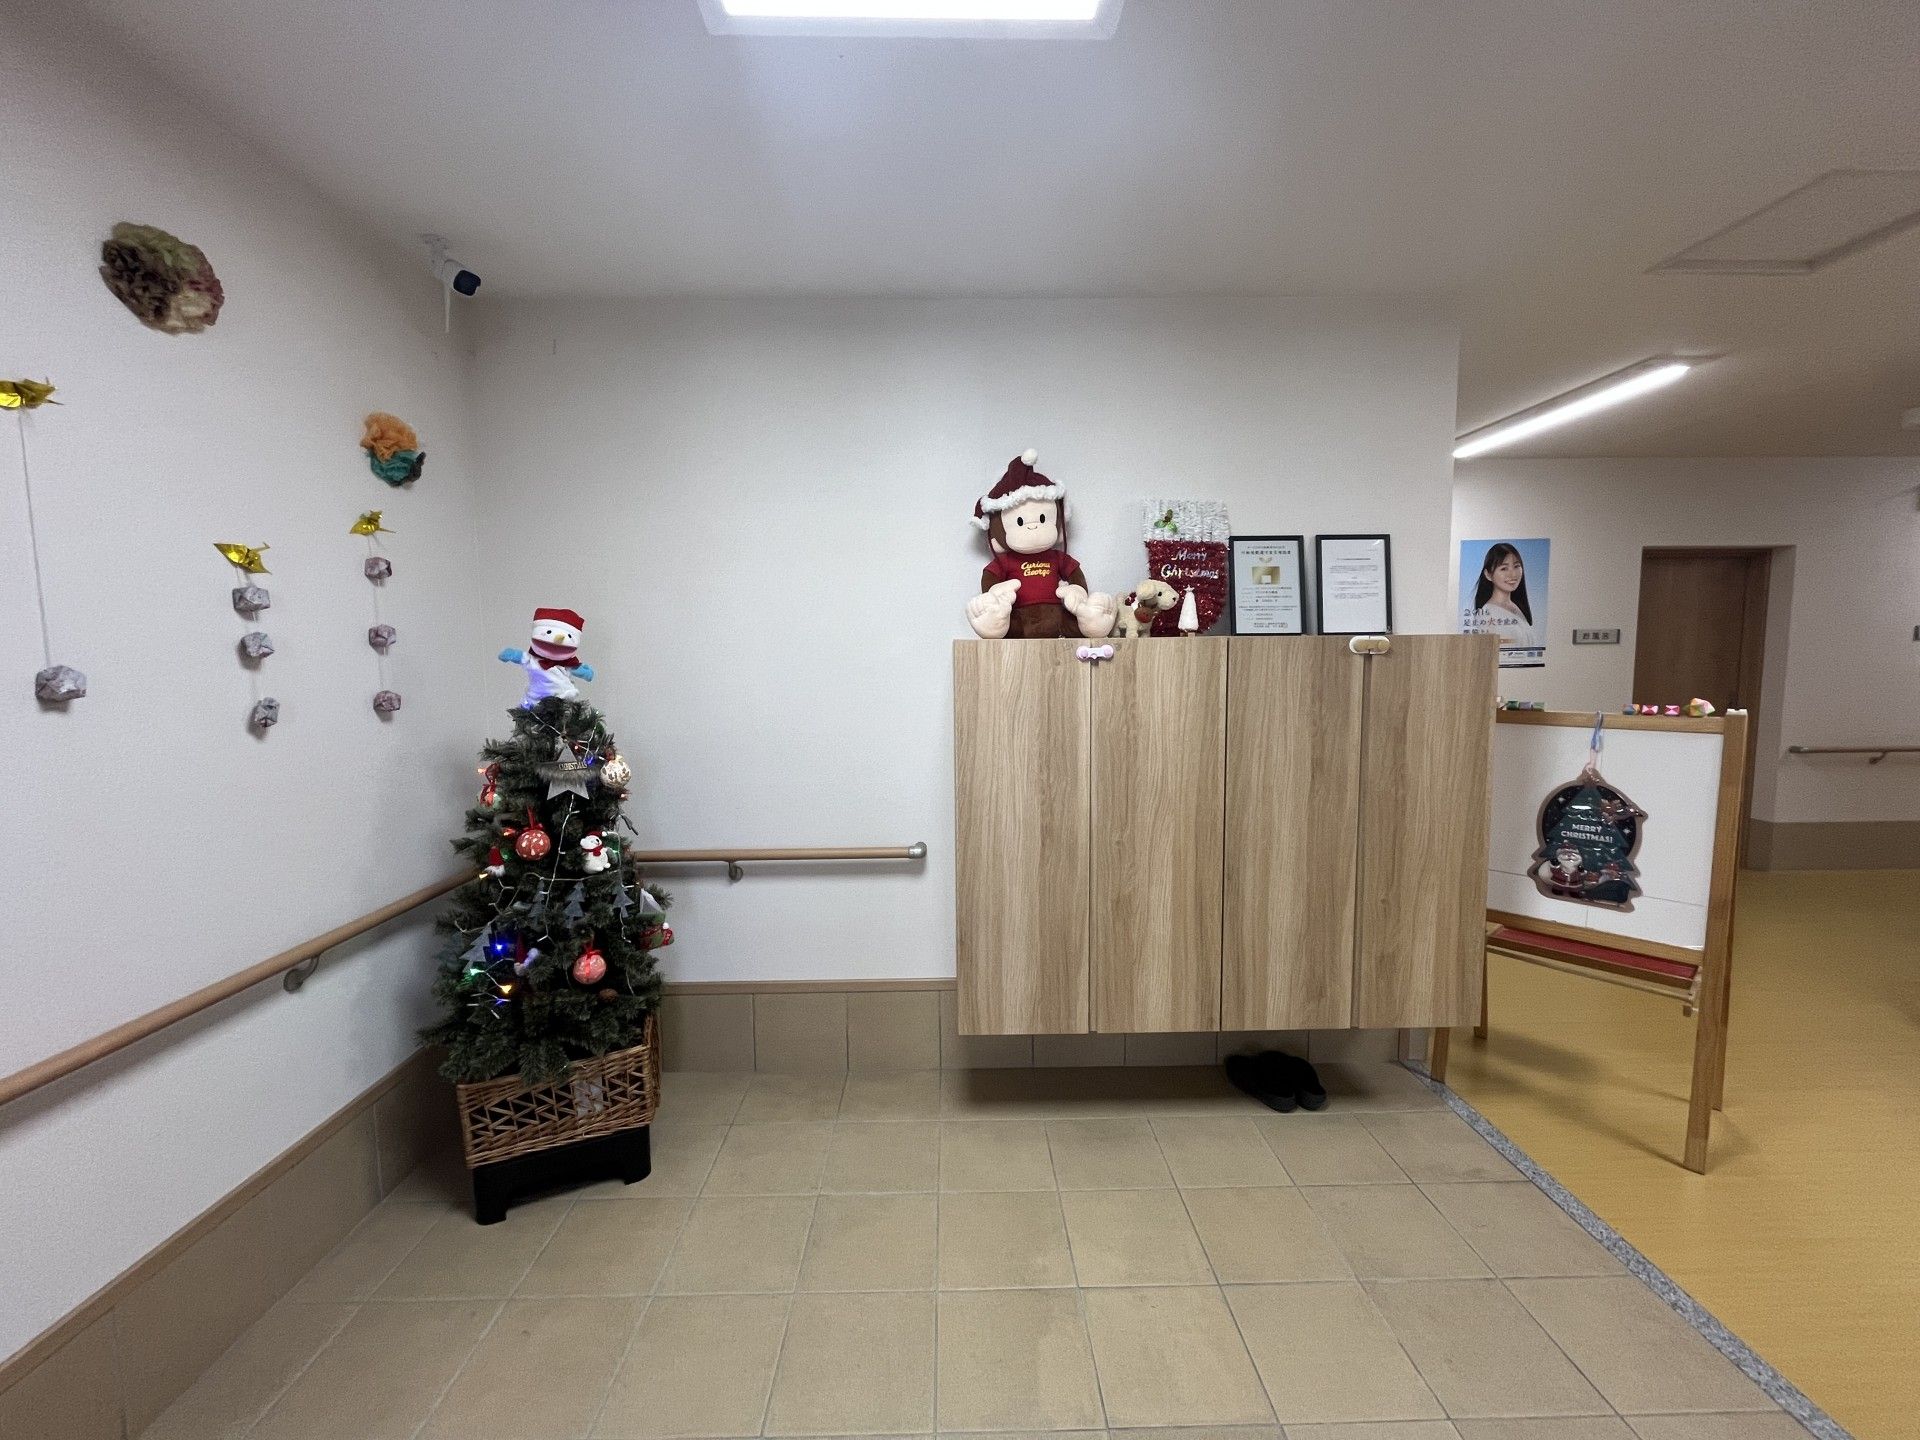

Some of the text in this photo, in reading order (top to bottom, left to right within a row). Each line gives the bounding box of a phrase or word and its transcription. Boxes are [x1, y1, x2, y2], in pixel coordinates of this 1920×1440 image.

[1171, 548, 1207, 561] Merry
[1023, 569, 1051, 577] George
[1160, 564, 1219, 579] Christmas
[1572, 823, 1602, 833] MERRY
[1560, 830, 1613, 844] CHRISTMAS!
